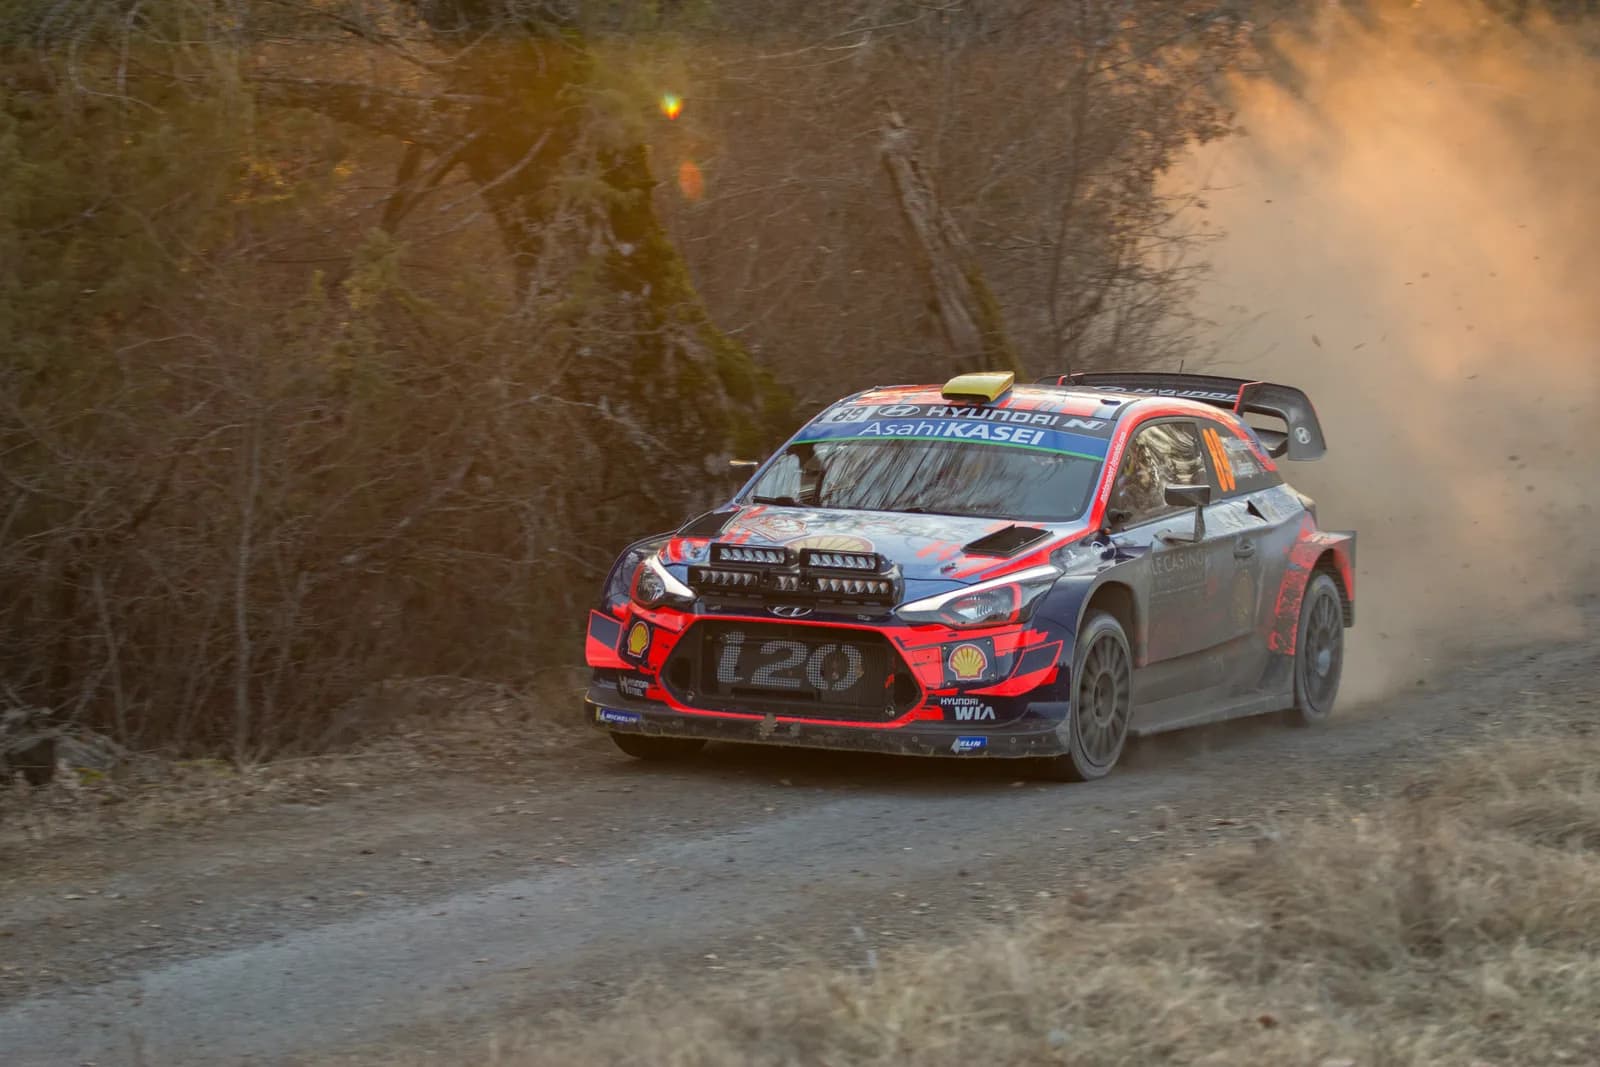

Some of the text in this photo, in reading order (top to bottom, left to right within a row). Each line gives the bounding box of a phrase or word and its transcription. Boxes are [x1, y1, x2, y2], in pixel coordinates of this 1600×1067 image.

[831, 406, 868, 422] 89
[926, 406, 1057, 426] HYUNDAI
[717, 632, 864, 690] i20
[940, 697, 979, 706] HYUNDAI
[954, 706, 996, 720] WIA
